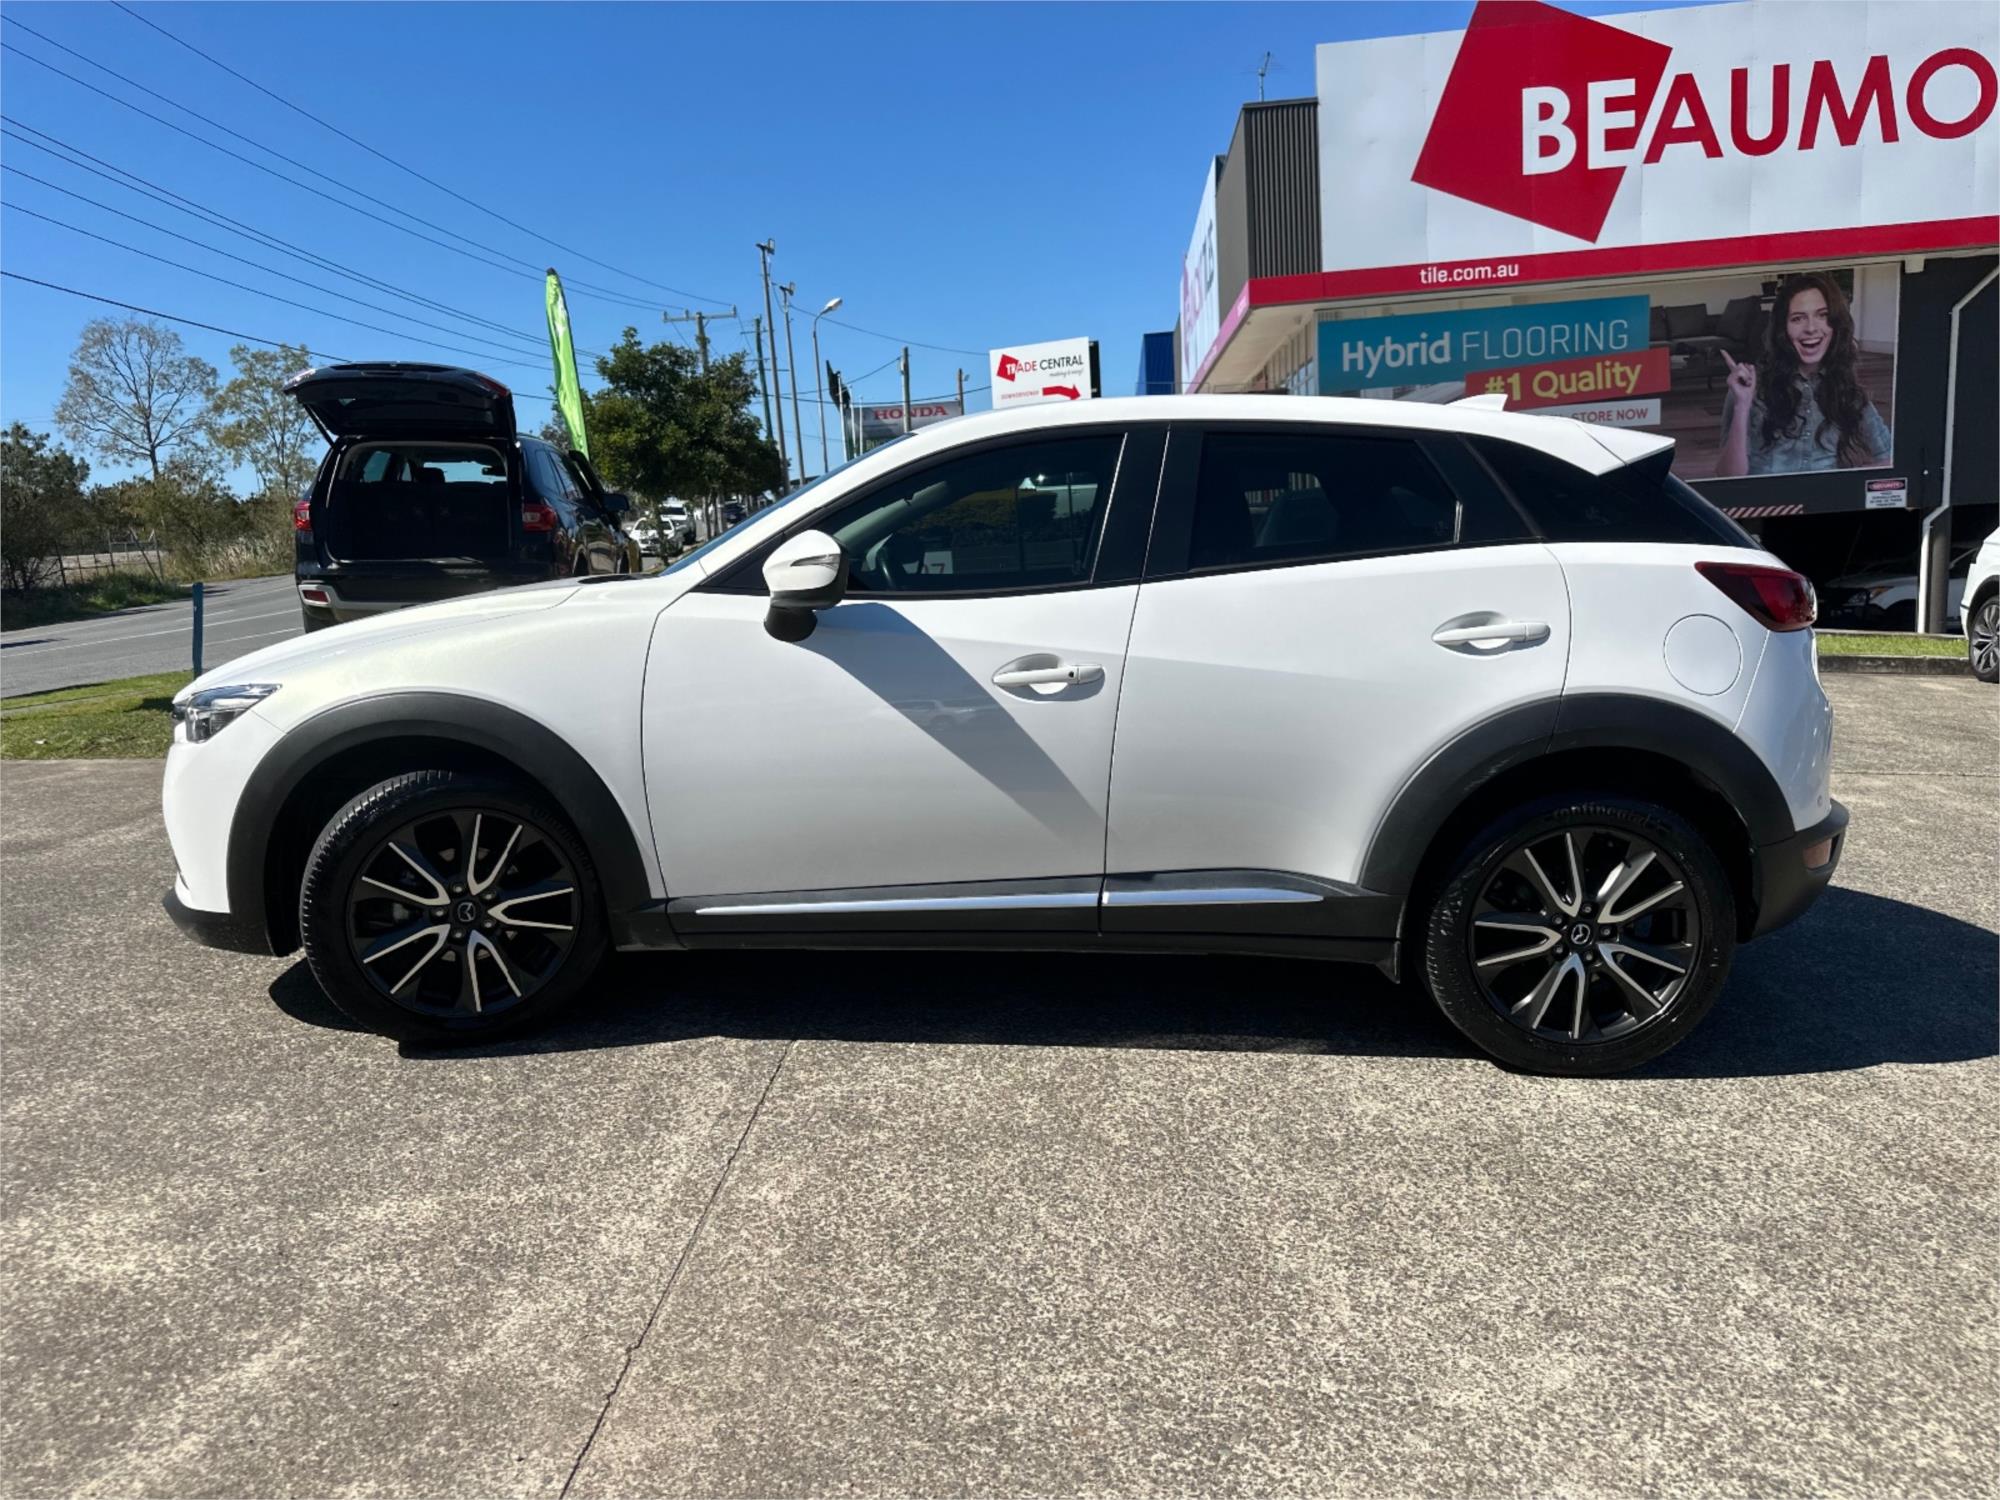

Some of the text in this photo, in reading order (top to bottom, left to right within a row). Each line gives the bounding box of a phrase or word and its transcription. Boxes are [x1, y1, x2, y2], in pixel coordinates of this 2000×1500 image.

[1522, 47, 1999, 175] BEAUMO
[1420, 263, 1519, 284] tile.com.au
[1342, 319, 1629, 378] Hybrid FLOORING
[1039, 354, 1084, 371] CENTRAL
[1485, 361, 1642, 401] #1 Quality
[873, 405, 949, 421] HONDA
[1616, 407, 1649, 421] NOW
